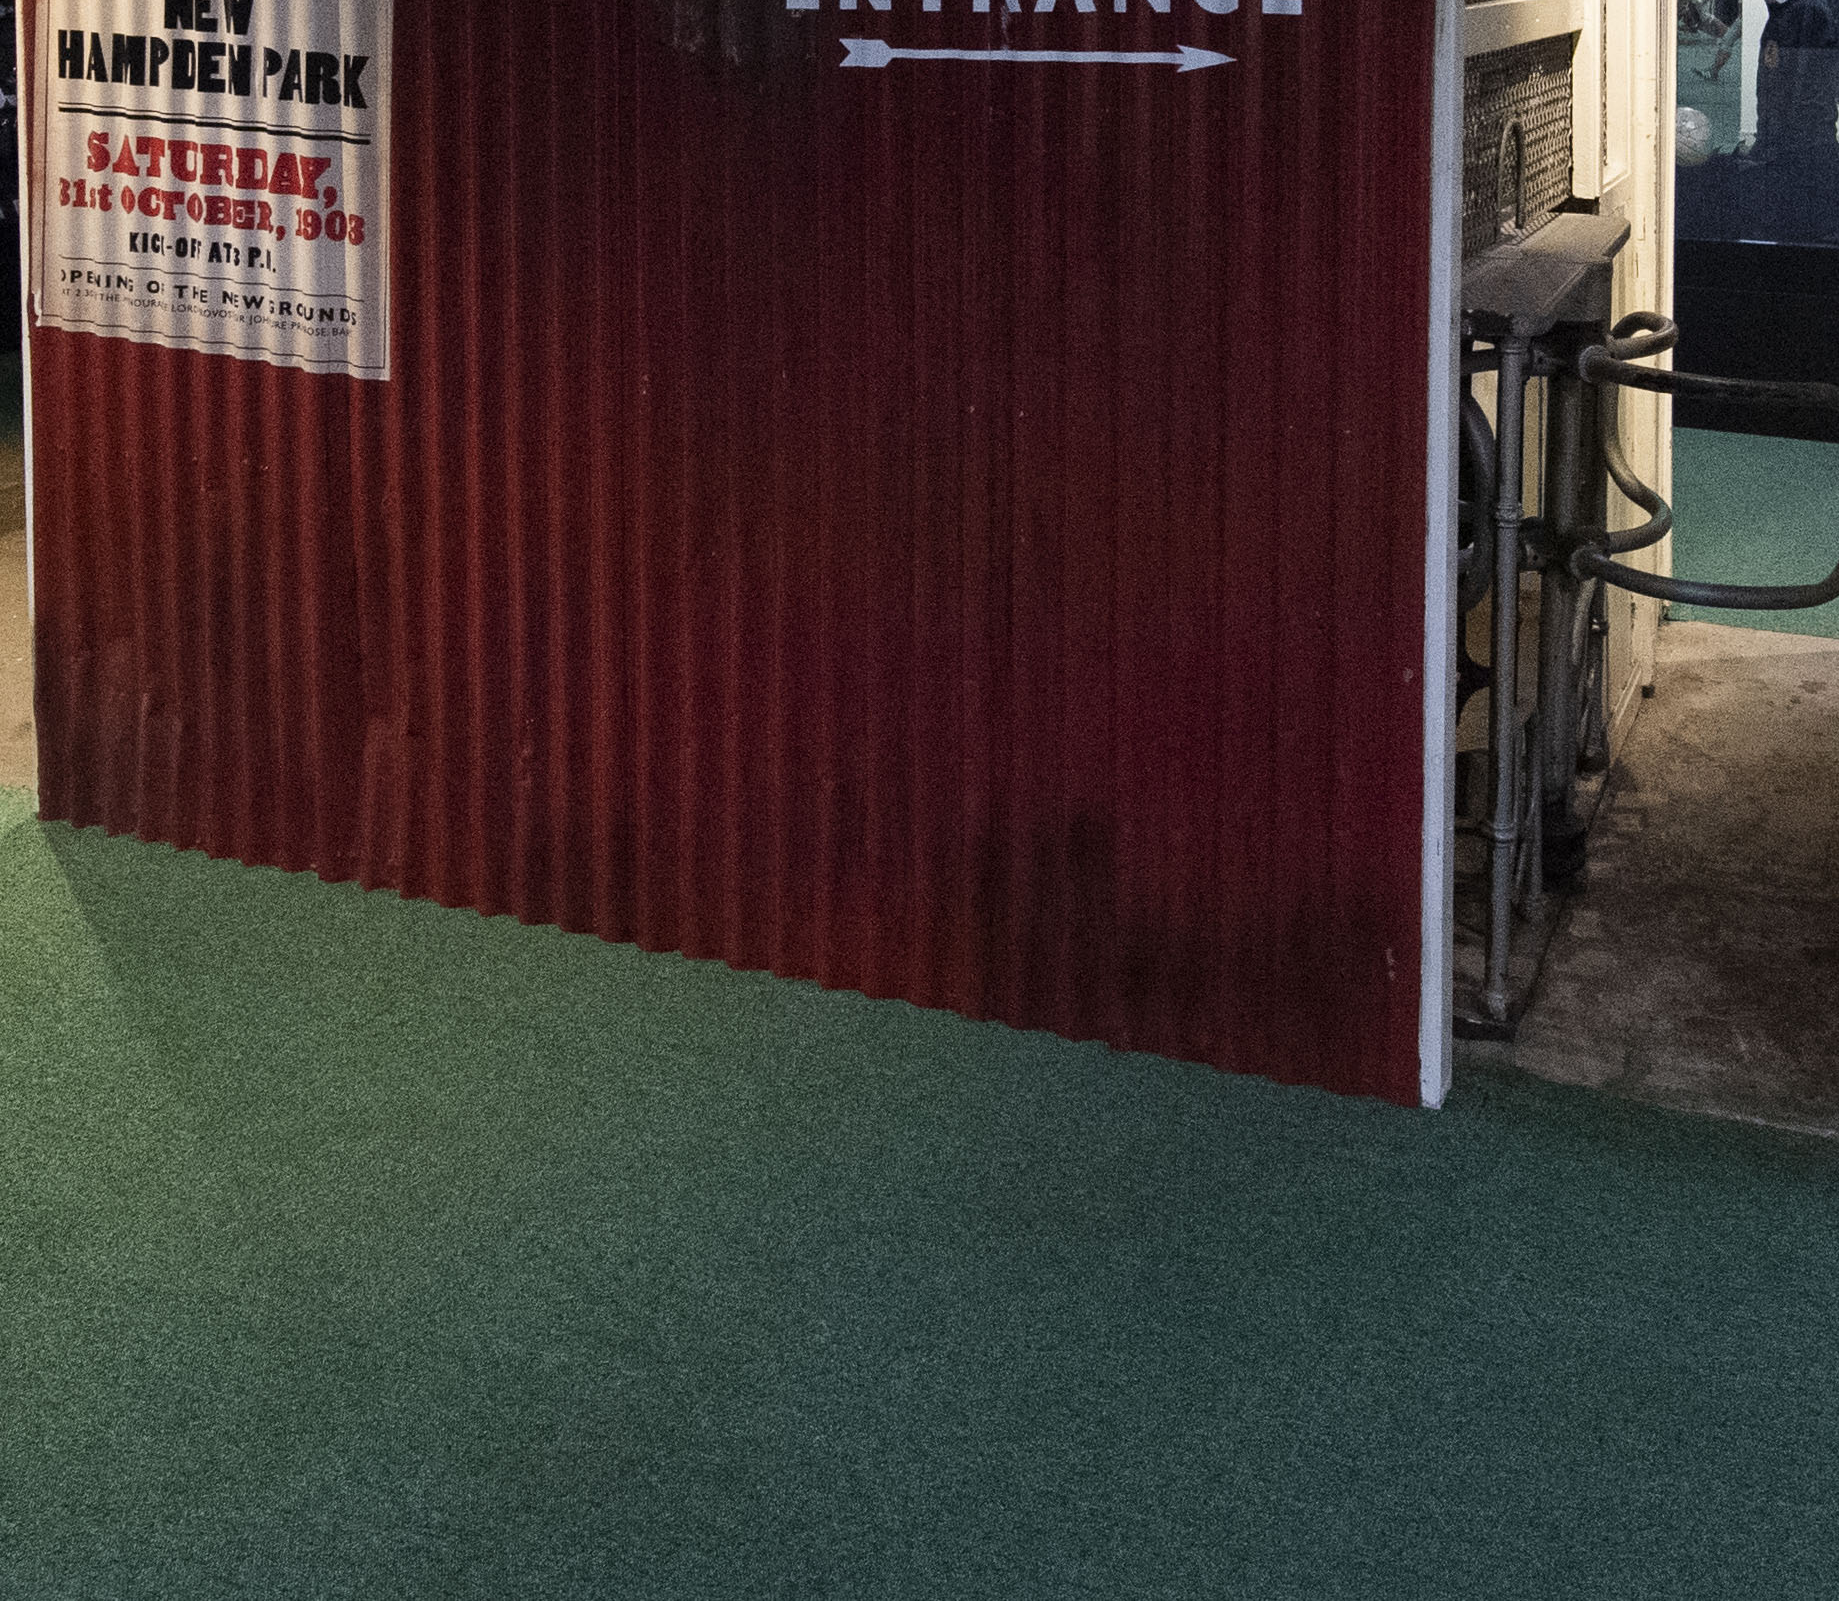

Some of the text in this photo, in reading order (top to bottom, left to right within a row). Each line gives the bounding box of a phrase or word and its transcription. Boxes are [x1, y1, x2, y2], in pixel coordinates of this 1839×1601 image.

[58, 29, 369, 109] HAMPDEN PARK
[87, 131, 337, 209] SATURDAY,
[120, 185, 287, 242] OCTOBER,
[295, 207, 365, 247] 1903
